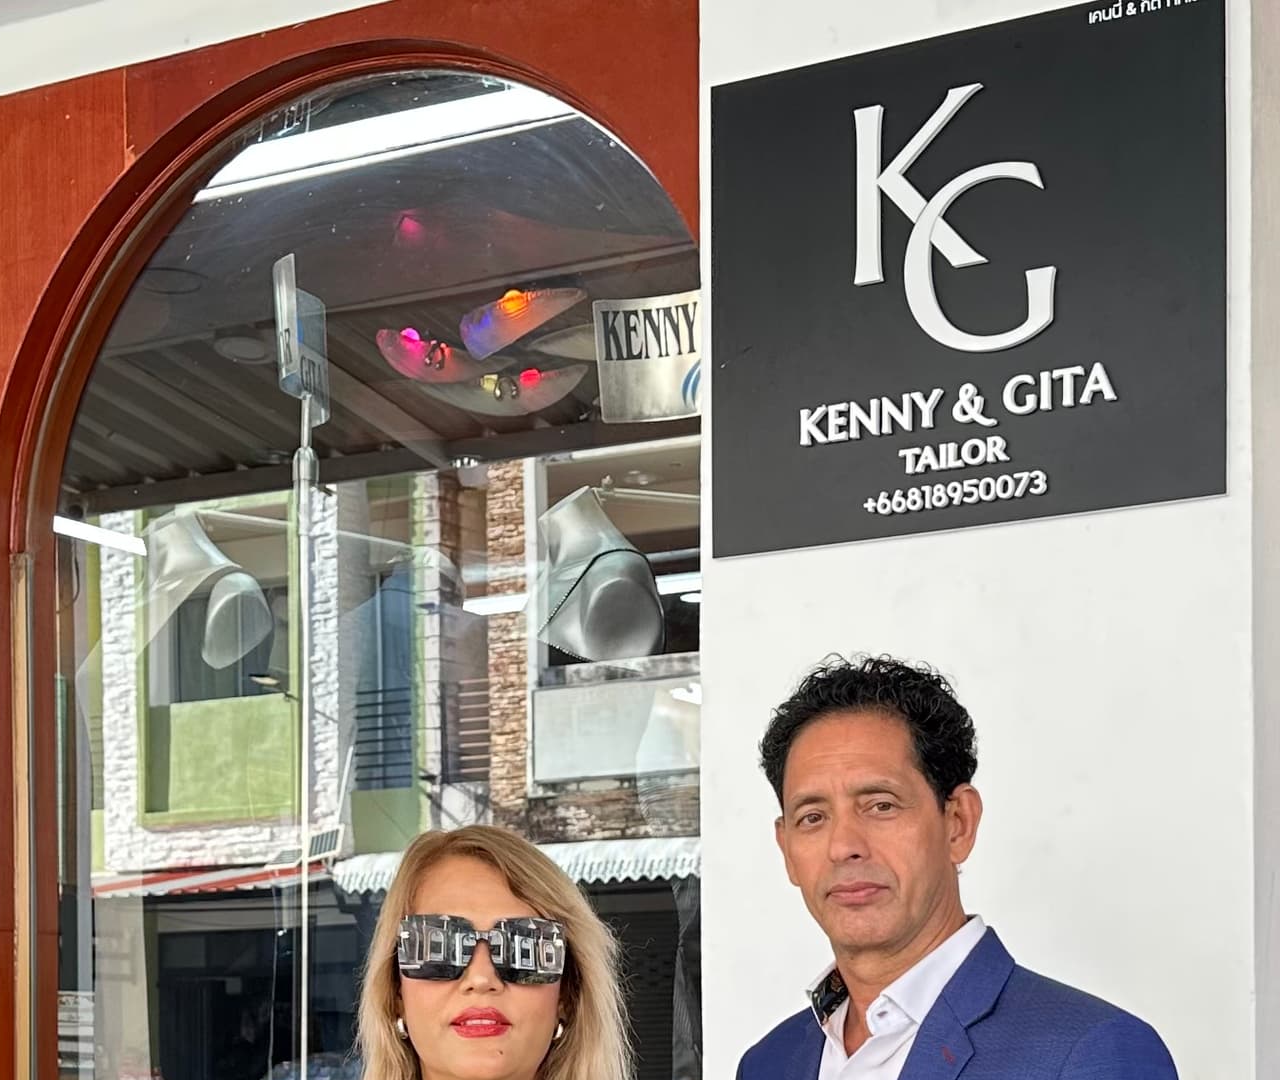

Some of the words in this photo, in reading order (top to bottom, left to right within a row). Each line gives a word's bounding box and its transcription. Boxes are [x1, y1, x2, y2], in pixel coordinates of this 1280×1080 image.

[600, 301, 698, 361] KENNY
[799, 388, 944, 446] KENNY
[952, 383, 998, 427] &
[1002, 362, 1118, 415] GITA
[898, 435, 1010, 474] TAILOR
[863, 470, 1048, 515] +66818950073
